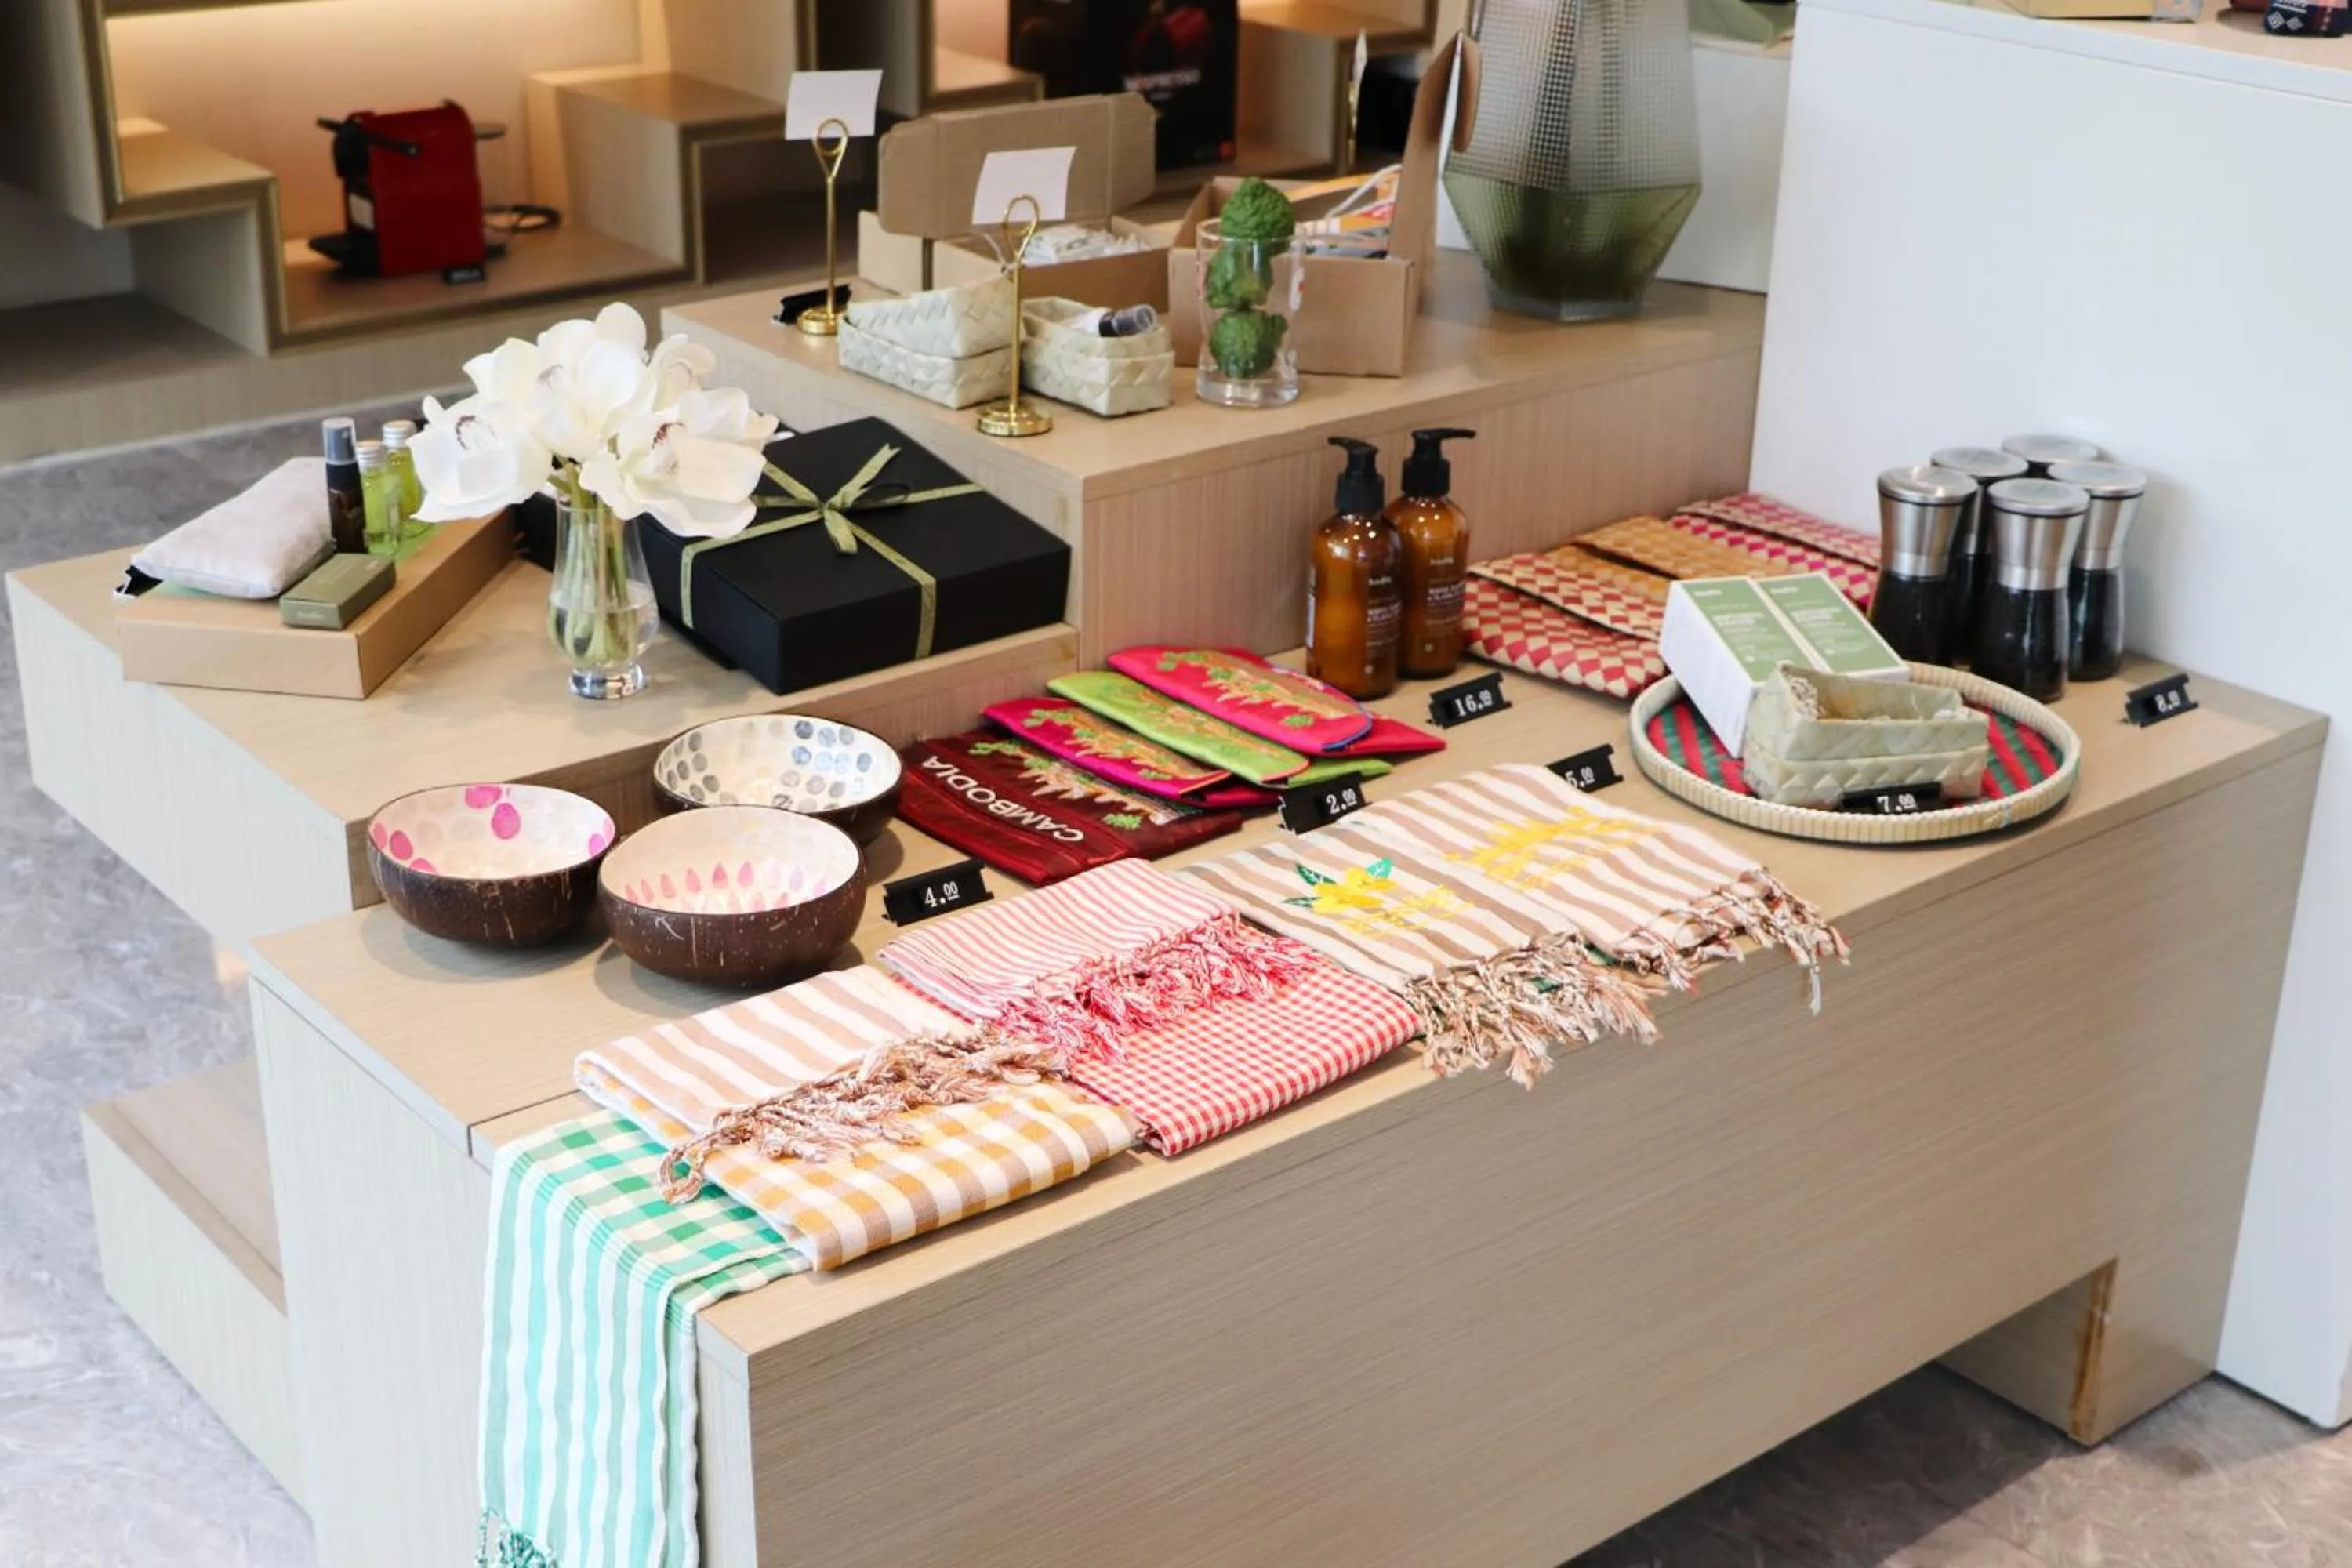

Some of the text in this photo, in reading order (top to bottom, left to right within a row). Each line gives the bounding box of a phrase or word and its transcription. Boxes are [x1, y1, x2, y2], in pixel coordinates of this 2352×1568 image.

[921, 755, 1084, 842] CAMBODIA
[1325, 788, 1358, 814] 2.00
[924, 880, 960, 908] 4.00
